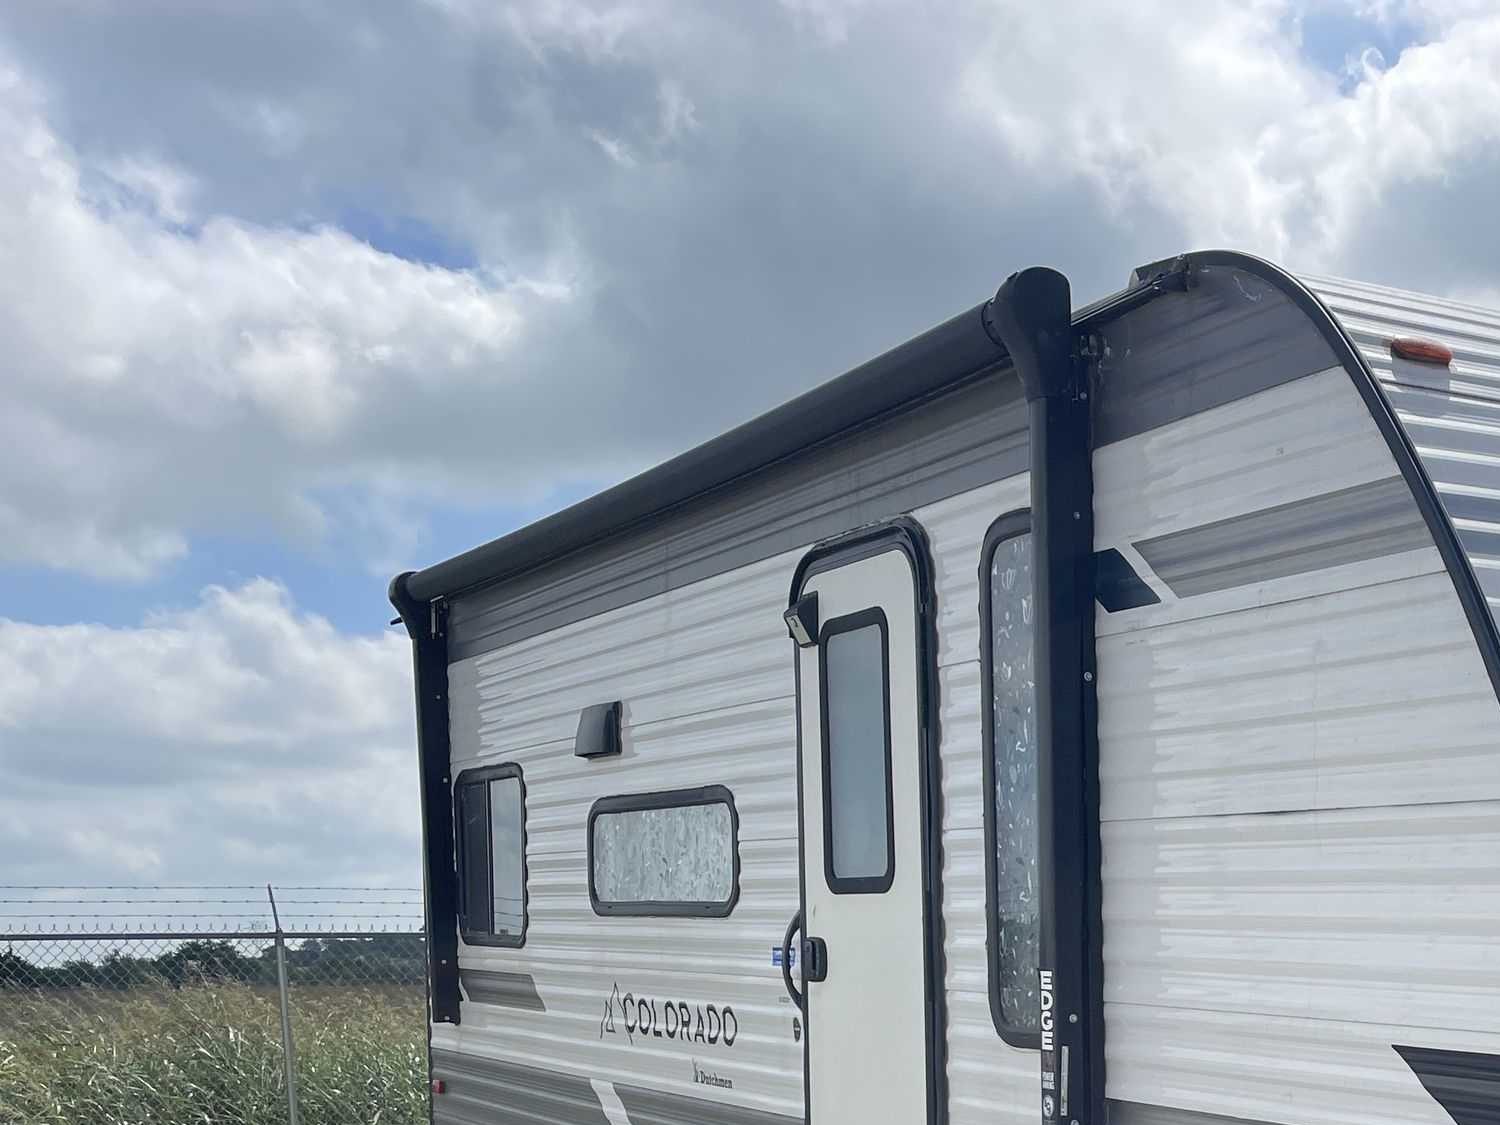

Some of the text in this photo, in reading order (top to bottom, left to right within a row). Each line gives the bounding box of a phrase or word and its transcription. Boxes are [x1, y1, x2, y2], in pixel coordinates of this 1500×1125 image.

[623, 992, 738, 1047] COLORADO
[1040, 970, 1054, 1051] EDGE
[700, 1070, 733, 1089] Dutchmen
